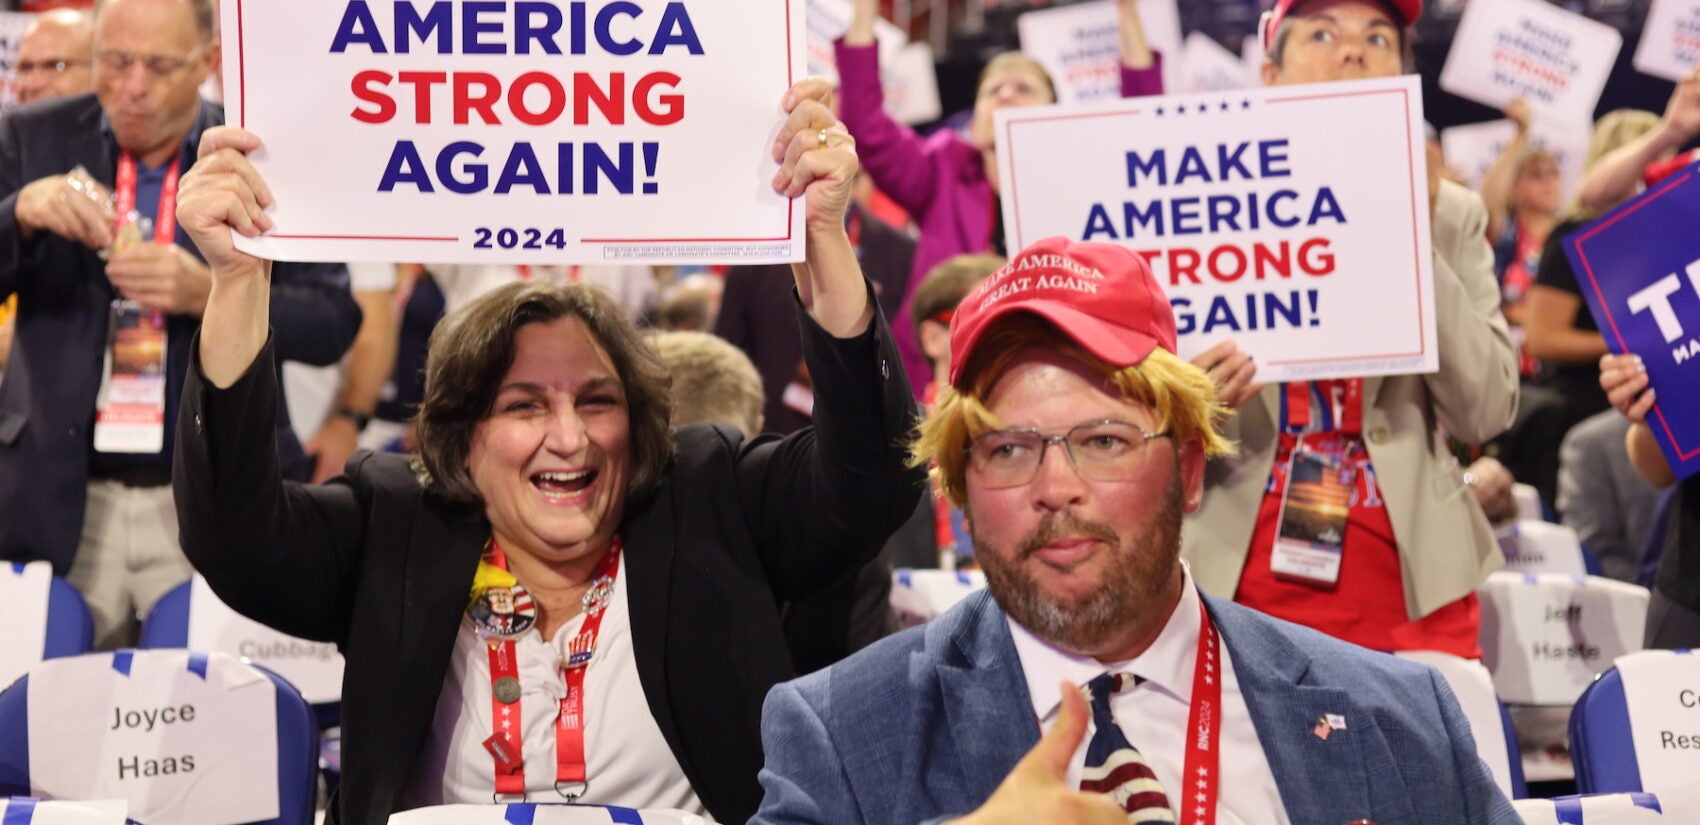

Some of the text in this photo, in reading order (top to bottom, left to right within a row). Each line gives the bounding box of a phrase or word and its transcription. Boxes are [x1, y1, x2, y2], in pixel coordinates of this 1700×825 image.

[330, 0, 705, 55] AMERICA
[351, 69, 685, 126] STRONG
[377, 140, 660, 195] AGAIN!
[1126, 138, 1292, 188] MAKE
[1082, 187, 1347, 240] AMERICA
[474, 227, 567, 250] 2024
[1136, 237, 1336, 286] TRONG
[977, 253, 1105, 296] MAKE AMERICA
[979, 274, 1098, 313] GREAT AGAIN
[1170, 289, 1320, 335] GAIN!
[111, 703, 196, 733] Joyce
[1197, 701, 1211, 750] RNC2024
[118, 754, 196, 781] Haas
